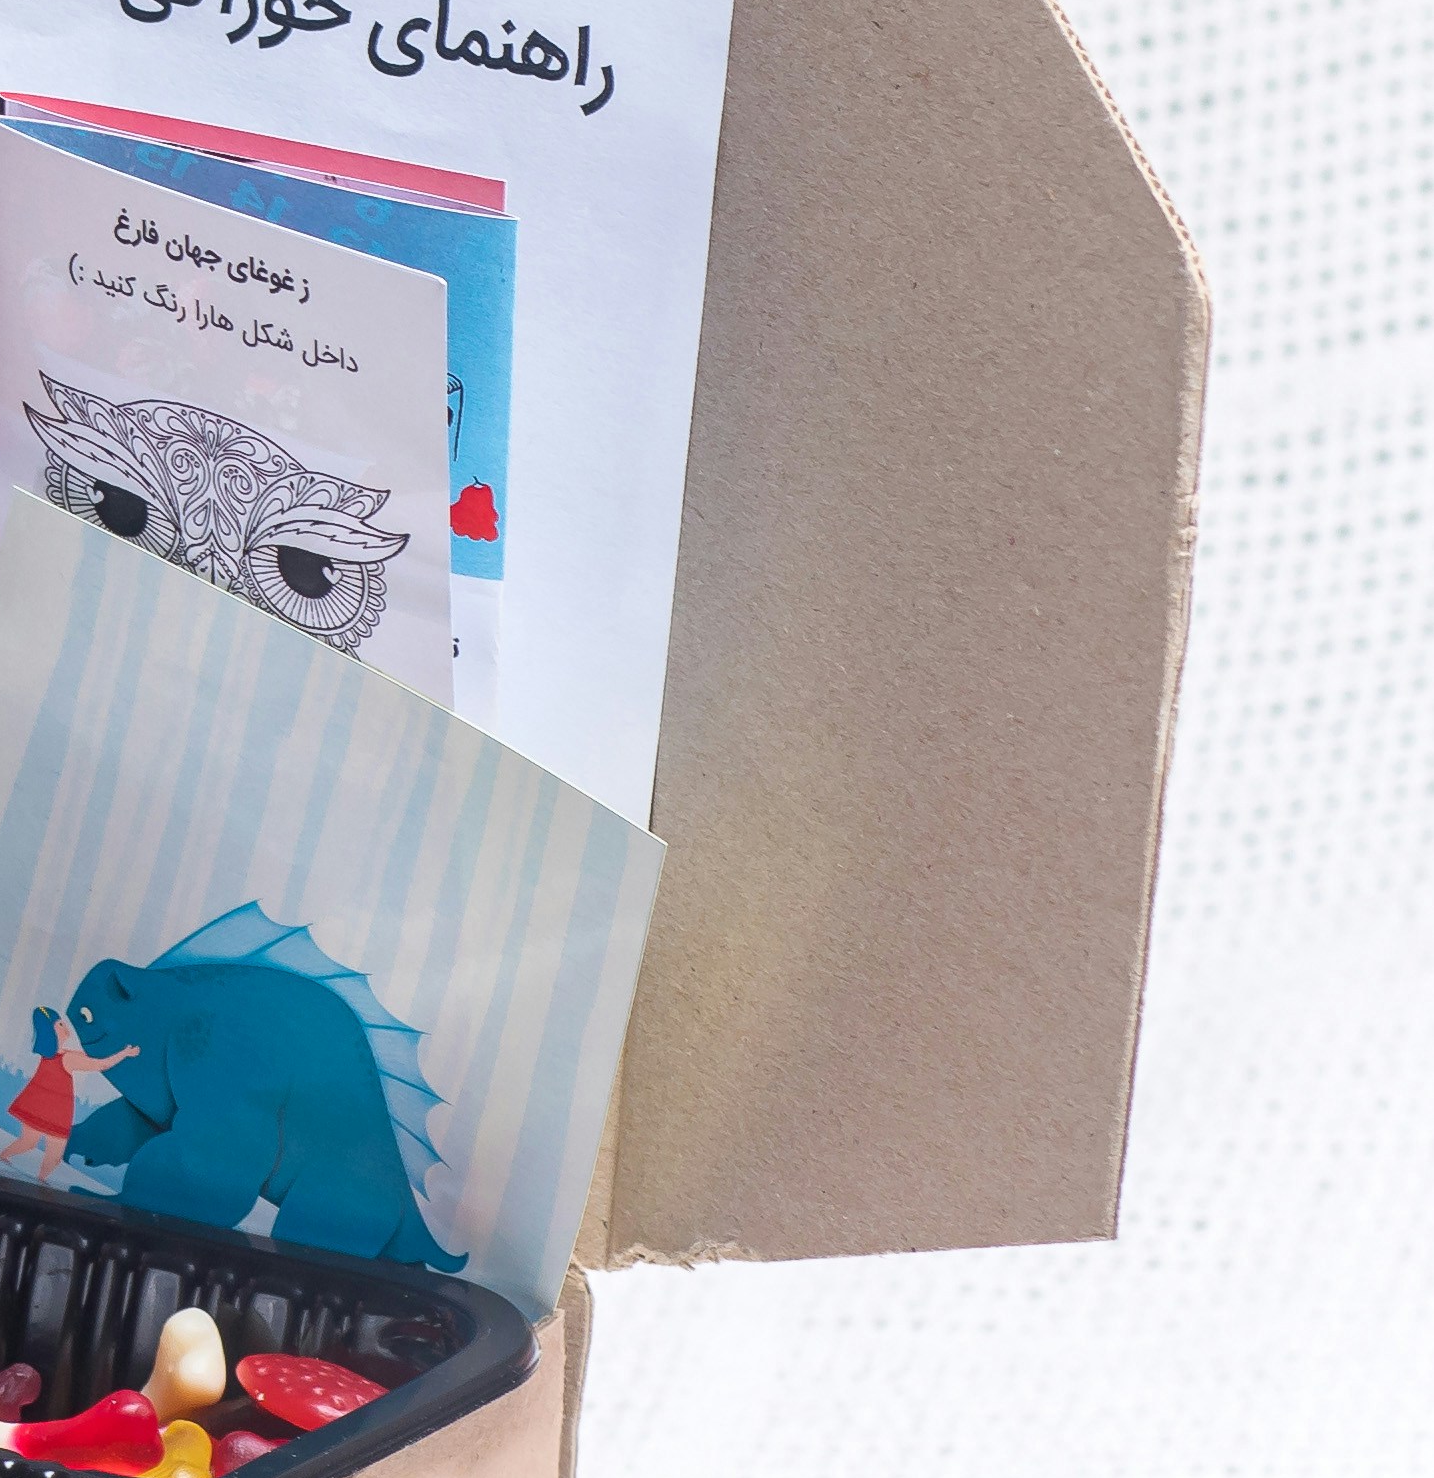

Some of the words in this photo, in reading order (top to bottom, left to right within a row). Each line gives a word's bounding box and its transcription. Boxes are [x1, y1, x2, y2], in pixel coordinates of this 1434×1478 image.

[113, 208, 159, 247] فارغ
[165, 234, 222, 272] جهان
[93, 269, 137, 297] کنید
[227, 256, 295, 294] غوغای
[143, 284, 187, 323] رنگ
[242, 319, 294, 352] شکل
[302, 339, 359, 373] داخل
